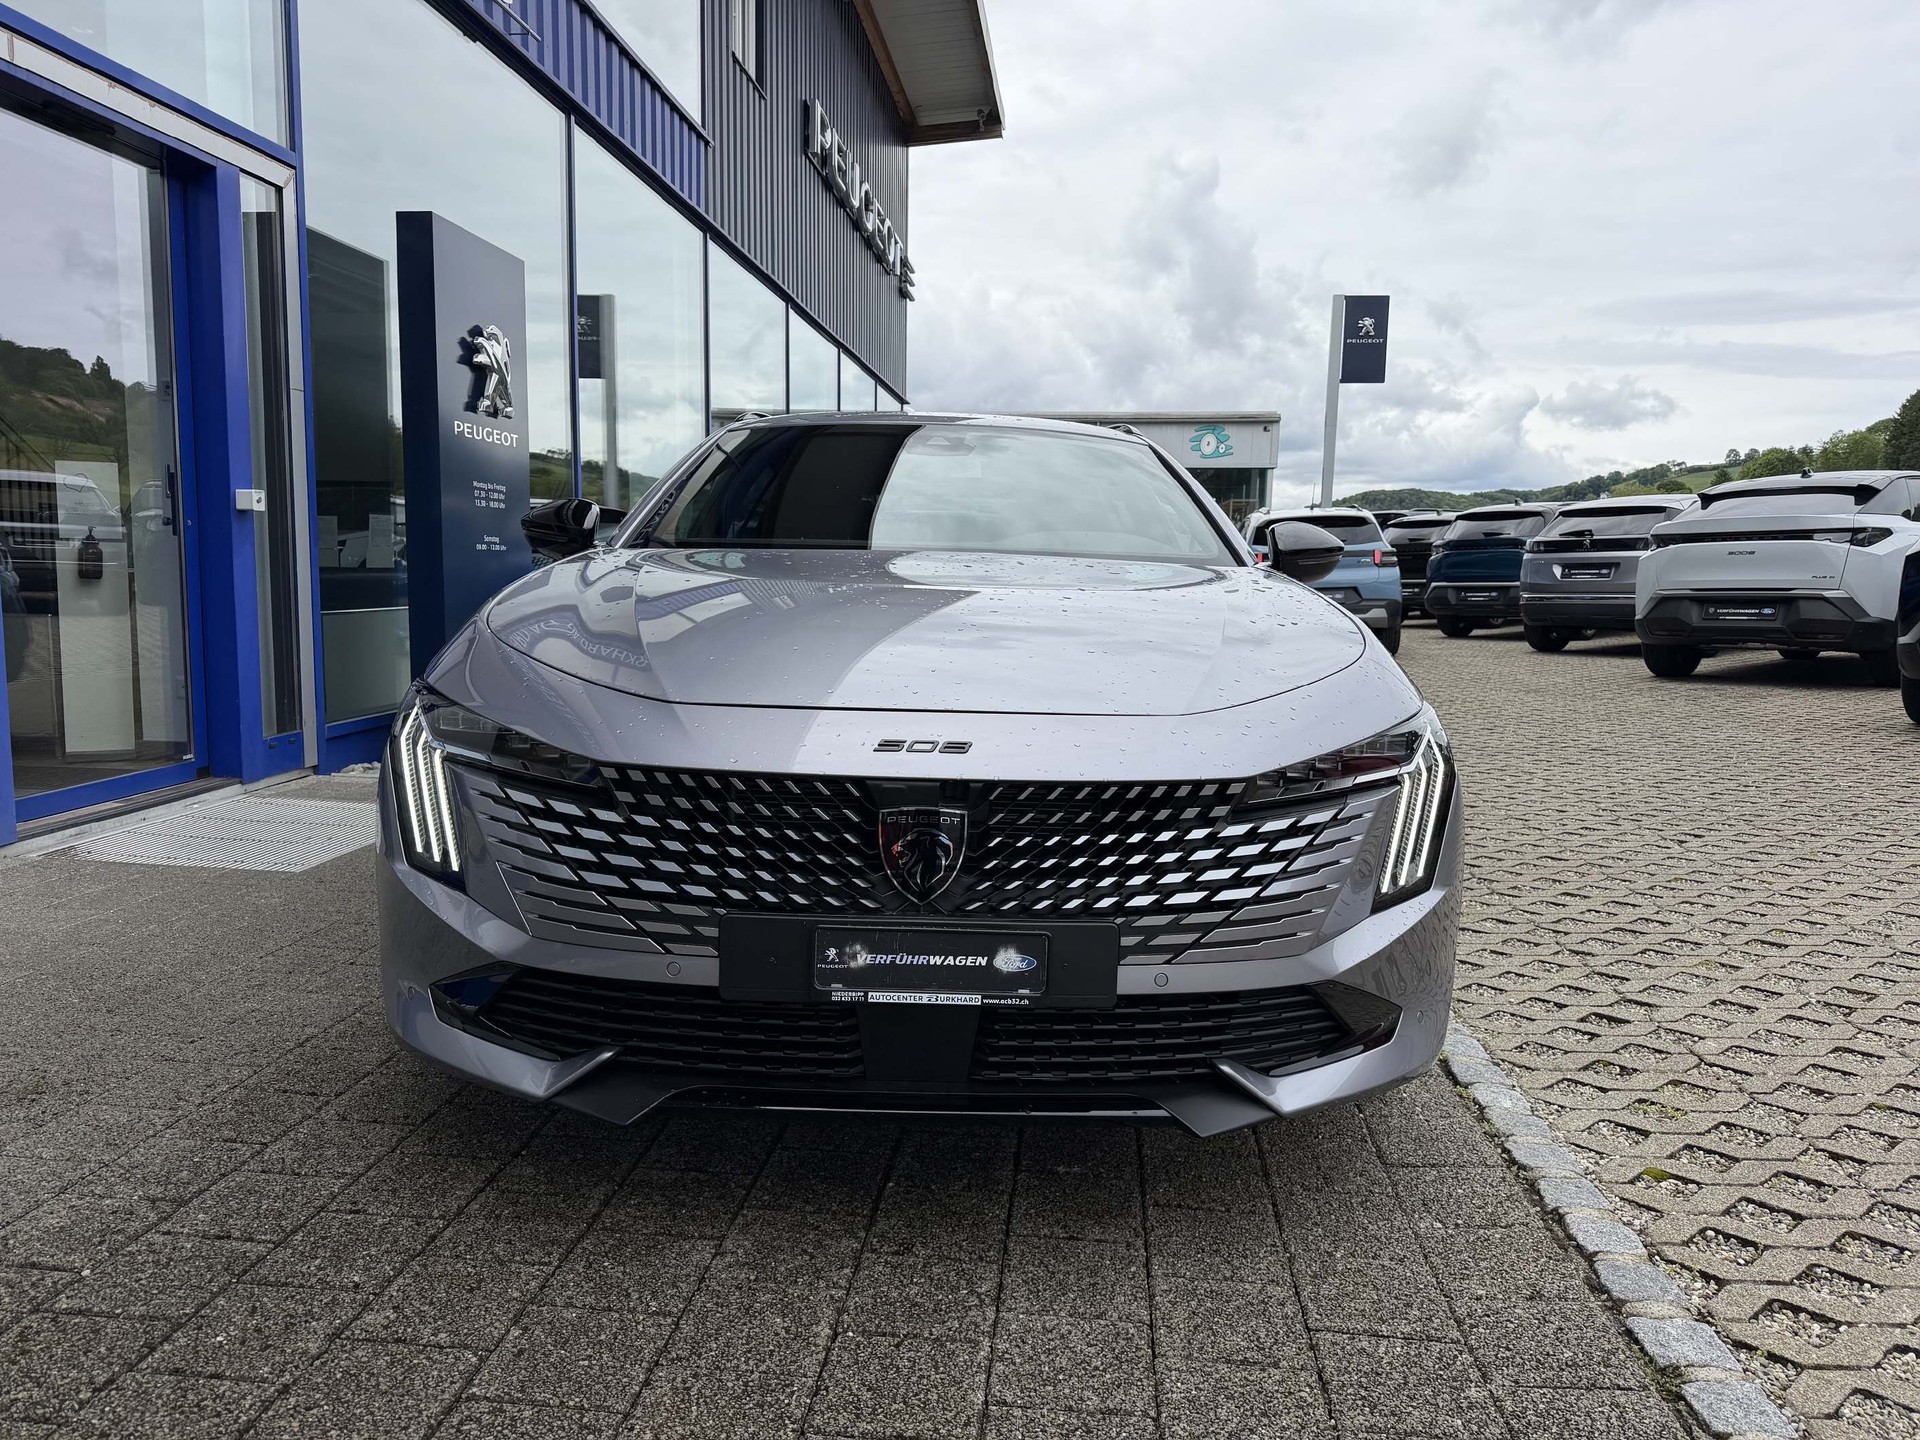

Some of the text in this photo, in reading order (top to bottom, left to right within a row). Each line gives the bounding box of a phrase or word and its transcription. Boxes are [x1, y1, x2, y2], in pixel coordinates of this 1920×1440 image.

[805, 98, 903, 275] PEUGEOT
[454, 420, 519, 448] PEUGEOT
[873, 738, 973, 754] 508
[887, 815, 961, 825] PEUGEOT
[856, 952, 988, 967] VERFÜHRWAGEN
[869, 994, 980, 1003] AUTOCENTER BURKHARD
